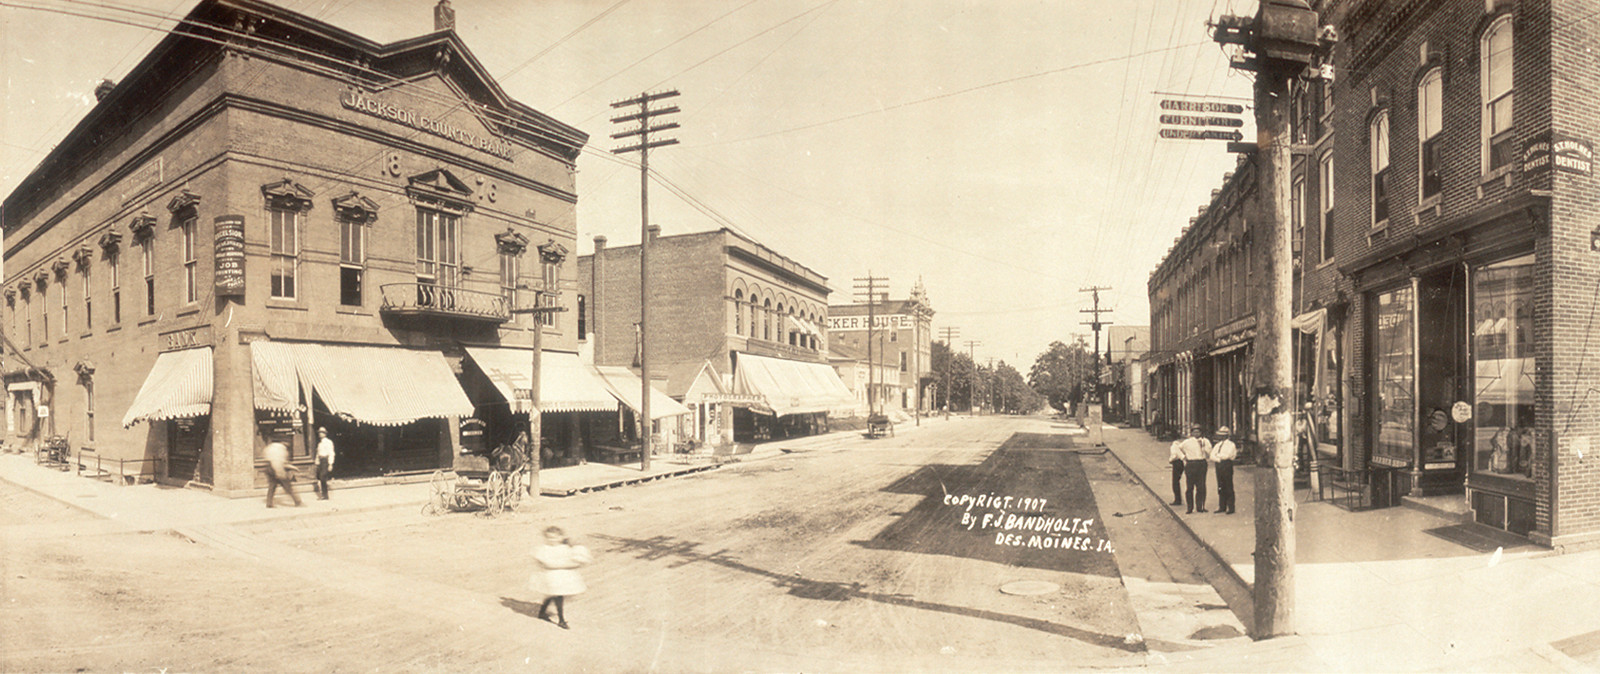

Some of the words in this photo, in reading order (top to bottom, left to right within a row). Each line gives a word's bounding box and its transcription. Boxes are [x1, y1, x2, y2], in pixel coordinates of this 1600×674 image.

[344, 92, 416, 127] JACKSON
[420, 116, 476, 147] COUNTY
[1523, 154, 1550, 172] DENTIST
[1555, 154, 1591, 172] DENTIST
